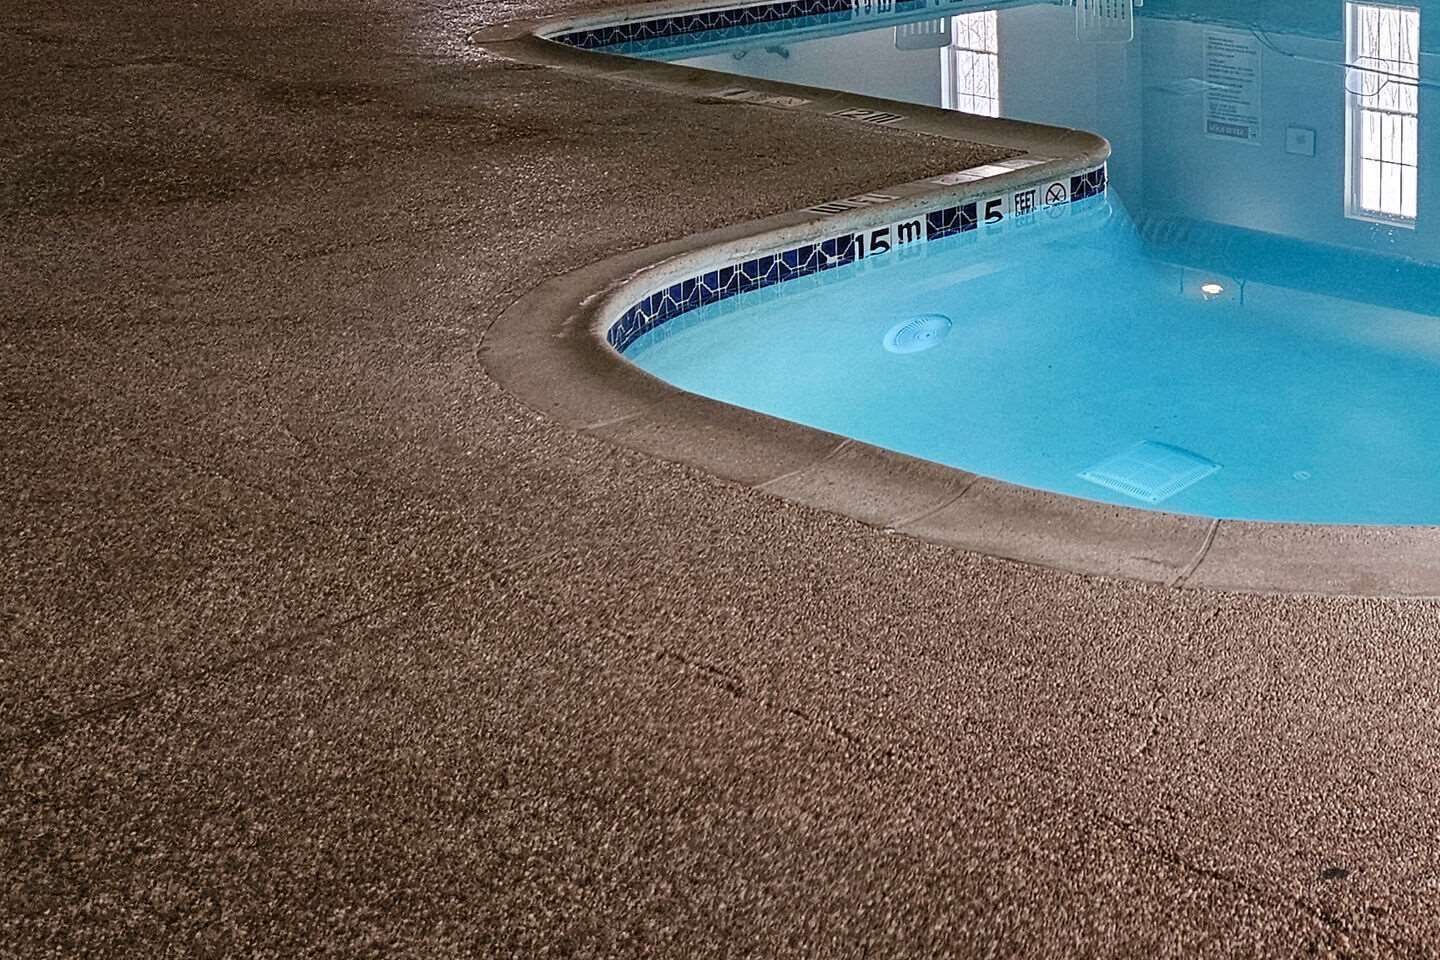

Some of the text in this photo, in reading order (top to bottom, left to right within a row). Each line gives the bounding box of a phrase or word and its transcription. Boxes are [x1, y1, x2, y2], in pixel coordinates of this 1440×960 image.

[985, 189, 1036, 225] 5 FEET
[898, 219, 921, 244] m
